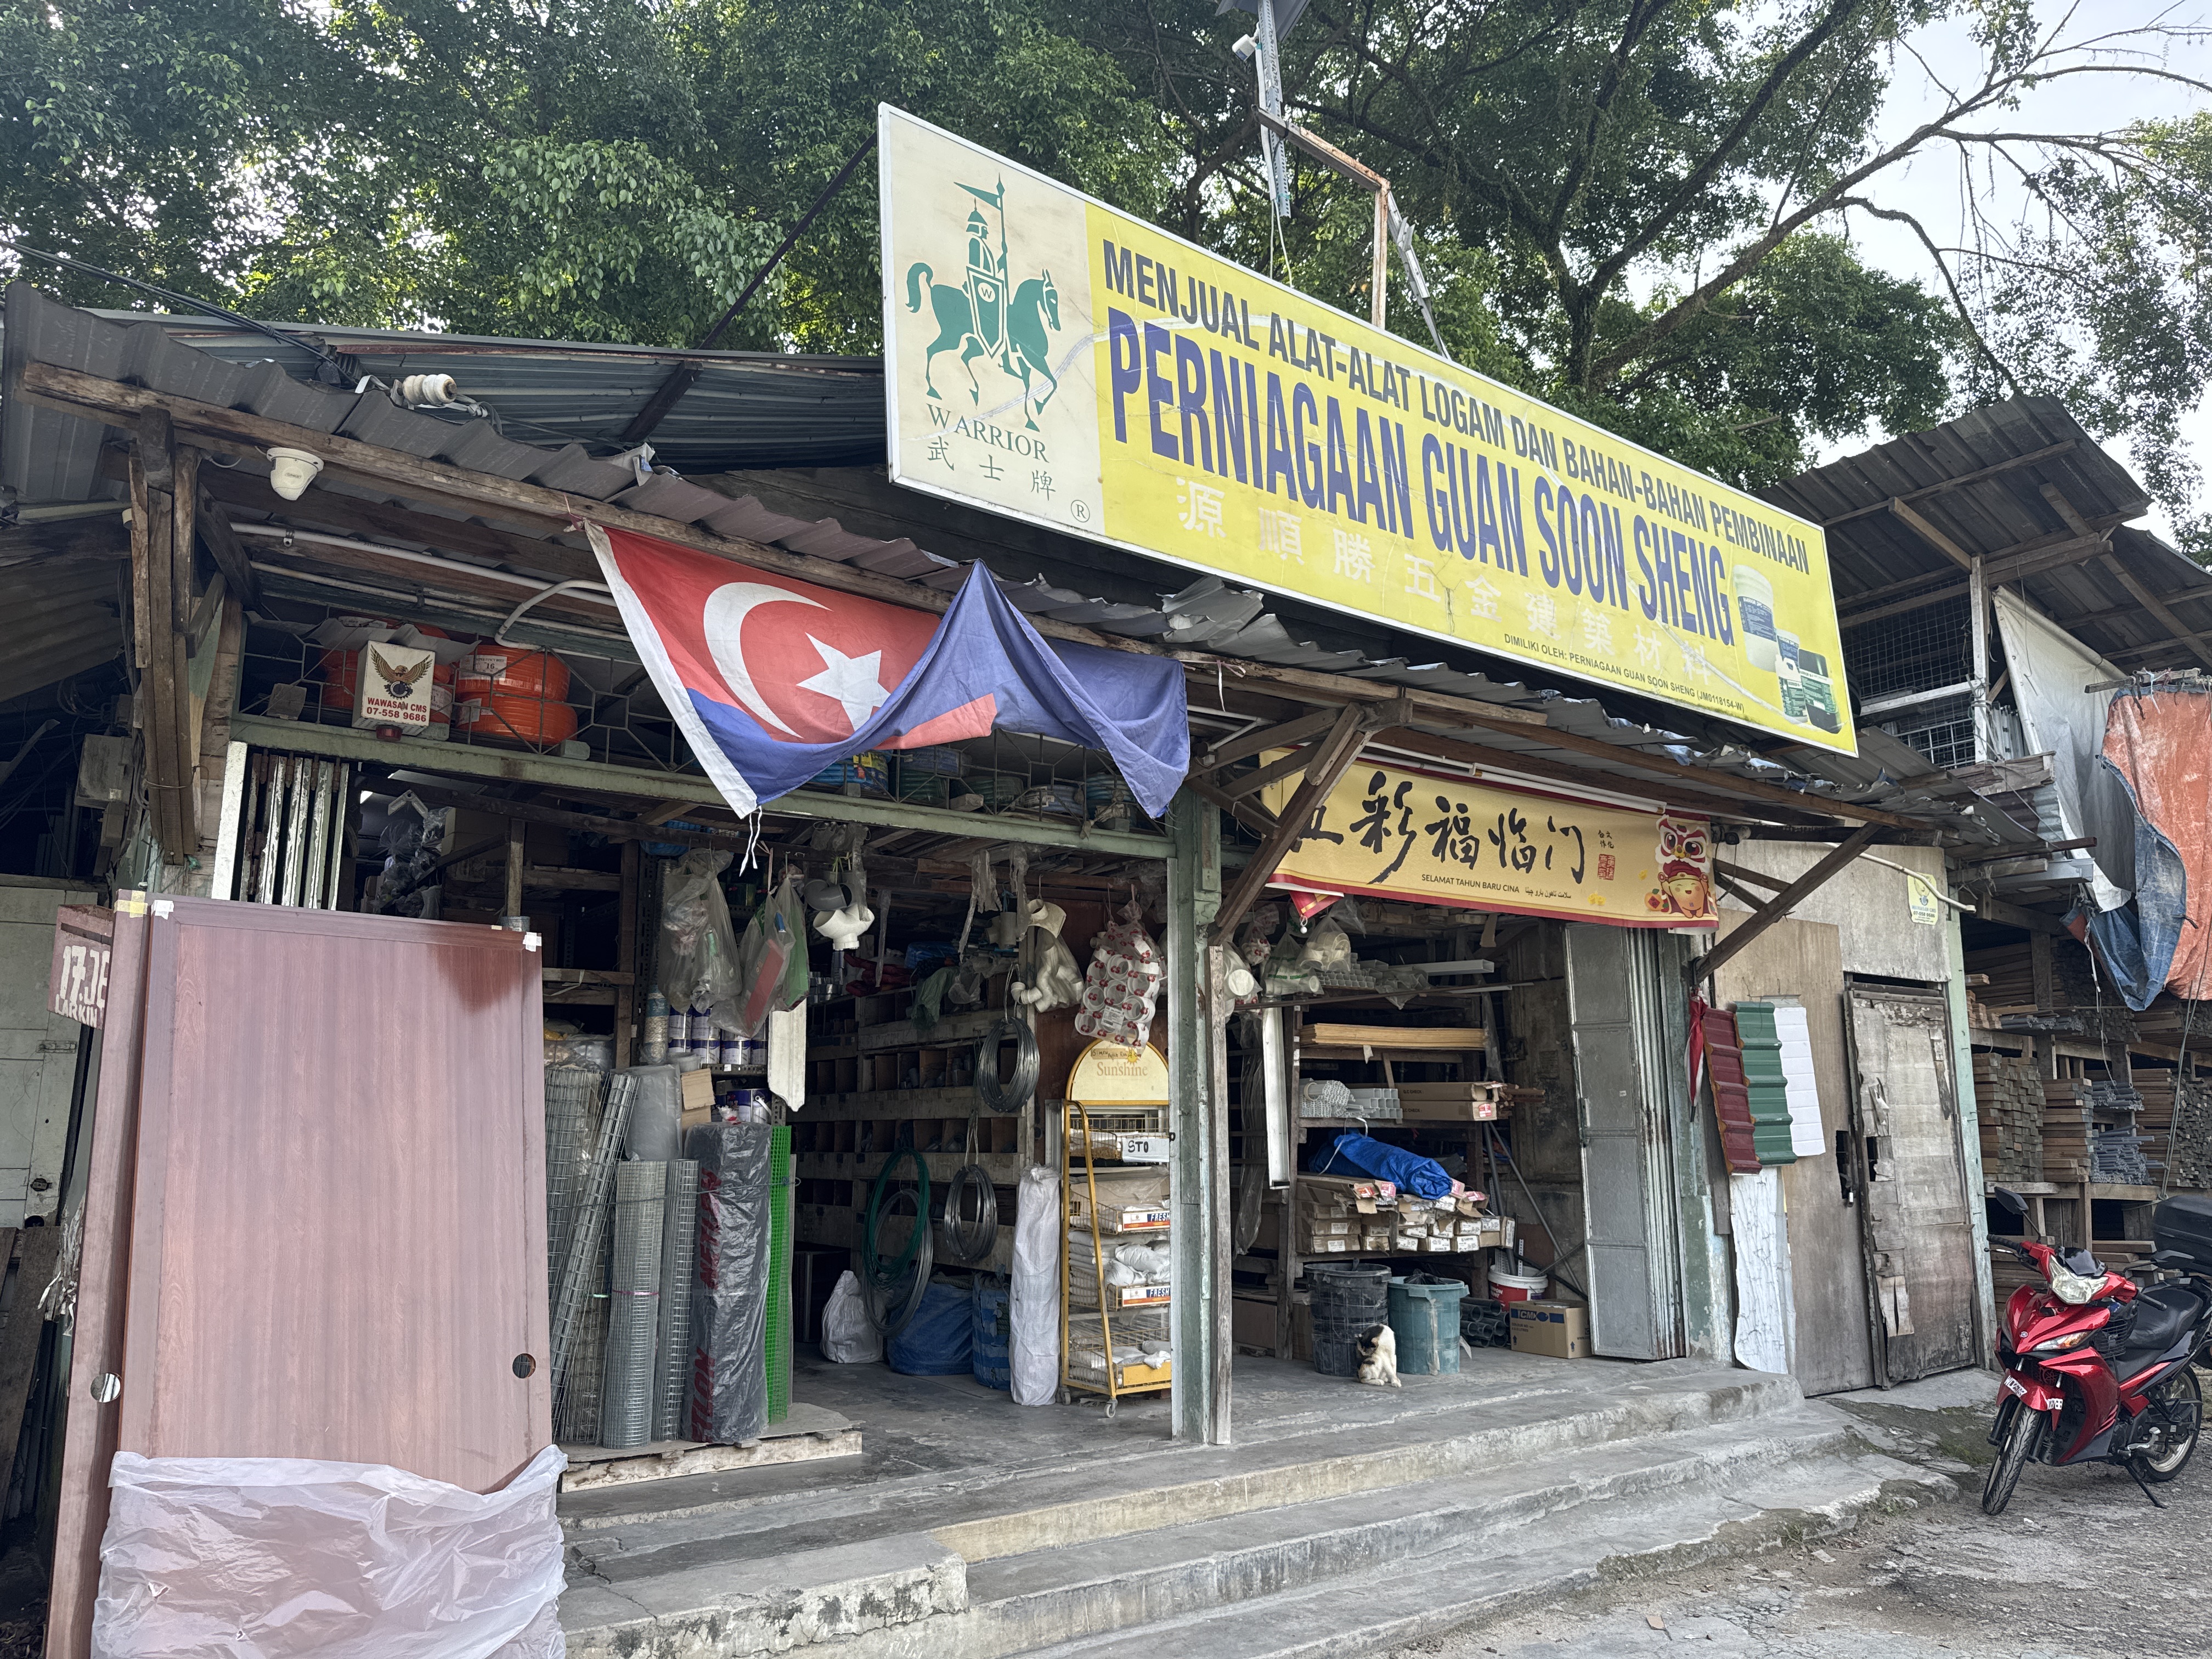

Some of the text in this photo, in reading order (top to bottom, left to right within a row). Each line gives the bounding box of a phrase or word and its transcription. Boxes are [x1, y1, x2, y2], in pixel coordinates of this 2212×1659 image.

[981, 286, 992, 299] W
[1103, 239, 1810, 575] MENJUAL ALAT-ALAT LOGAM DAN BAHAN-BAHAN PEMBINAAN
[927, 403, 1050, 463] WARRIOR
[927, 436, 1057, 501] 武士牌
[1108, 306, 1735, 646] PERNIAGAAN GUAN SOON SHENG
[1504, 633, 1745, 713] DIMILIKI OLEH: PERNIAGAAN GUAN SOON SHENG (JM0118154-W)
[368, 697, 427, 713] WAWASAN CMS
[367, 707, 426, 722] 07-558 9686
[1422, 874, 1520, 893] SELAMAT TAHUN BARU CINA
[1088, 992, 1097, 1001] CS
[55, 994, 97, 1028] LARKIN
[1097, 1062, 1148, 1076] Sunshine
[1150, 1213, 1170, 1221] FRESH
[1150, 1288, 1170, 1297] FRESH
